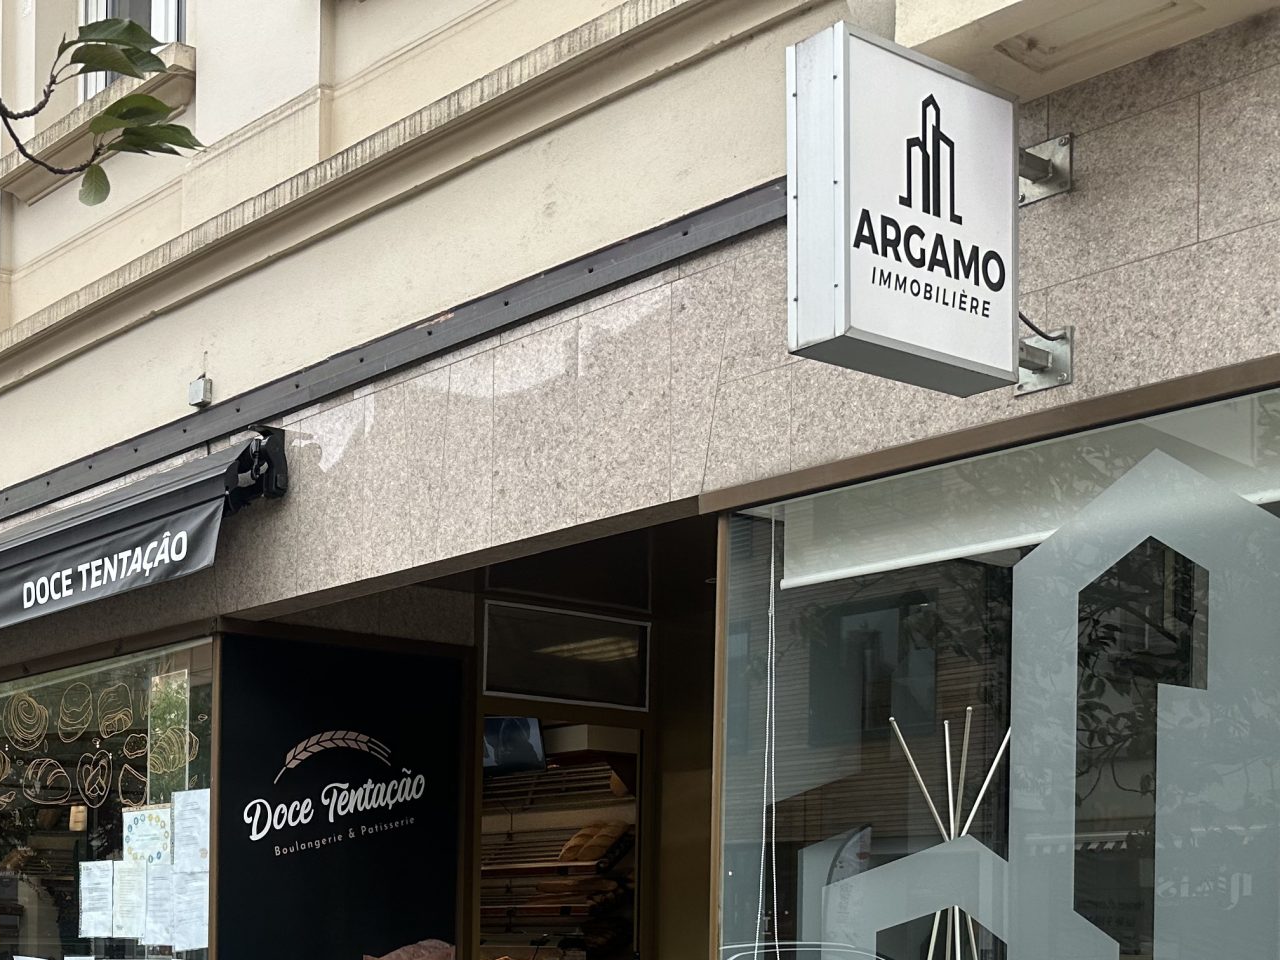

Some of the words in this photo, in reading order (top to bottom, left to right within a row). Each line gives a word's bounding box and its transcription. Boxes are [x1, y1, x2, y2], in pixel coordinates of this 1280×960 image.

[853, 208, 1006, 292] ARGAMO
[871, 266, 991, 318] IMMOBILIÈRE
[22, 567, 74, 609] DOCE
[243, 798, 315, 841] Doce
[321, 767, 426, 823] Tentação
[274, 833, 343, 856] Boulangerie
[348, 828, 356, 839] &
[361, 816, 416, 835] Patisserie
